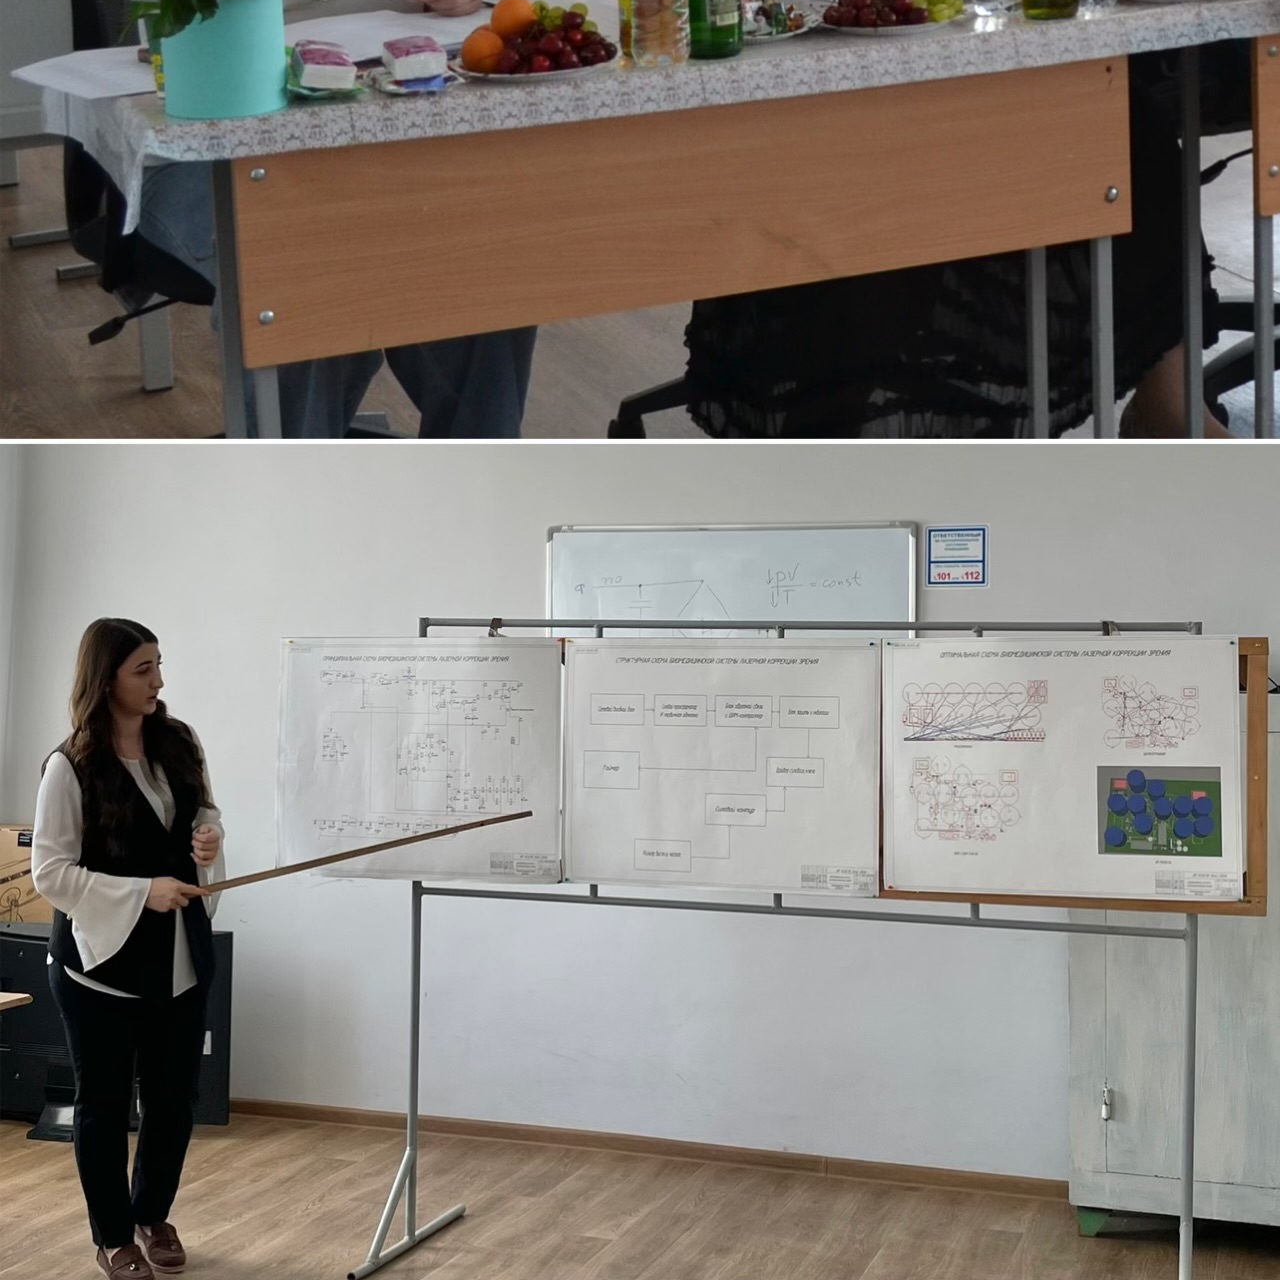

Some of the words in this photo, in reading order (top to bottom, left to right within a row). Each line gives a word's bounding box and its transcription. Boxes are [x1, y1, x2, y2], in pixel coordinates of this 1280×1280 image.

[822, 570, 863, 589] const
[936, 572, 951, 580] 101
[964, 571, 981, 580] 112
